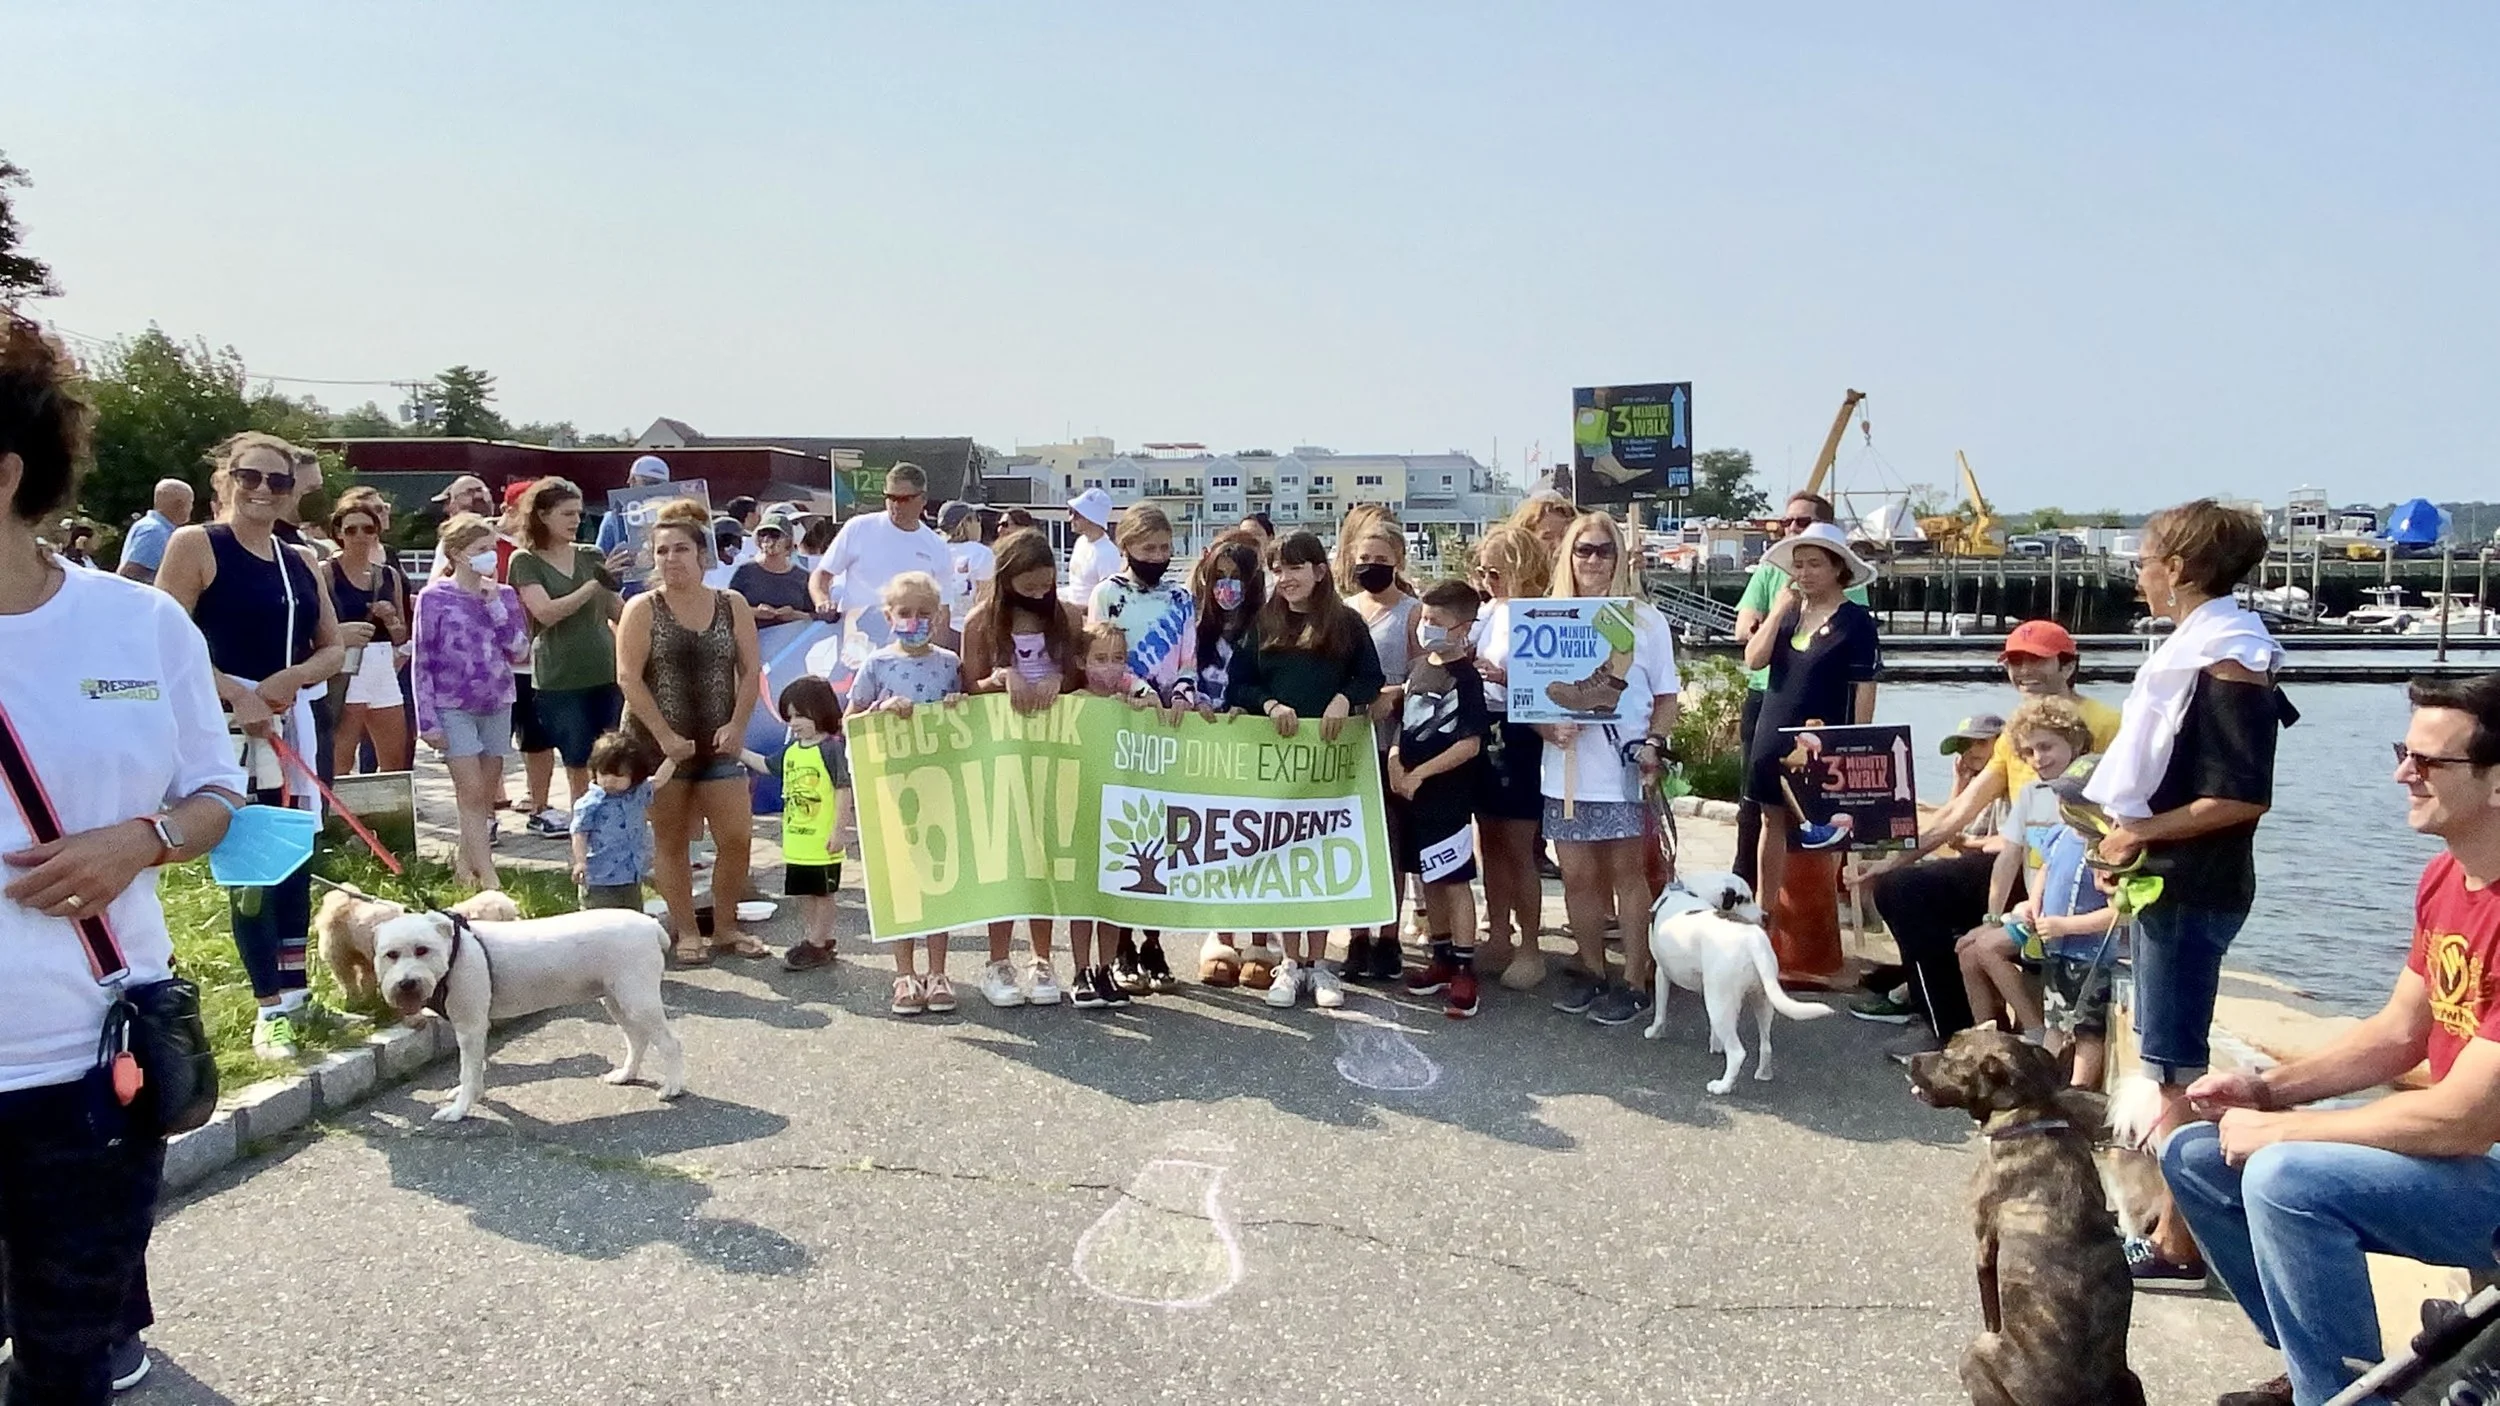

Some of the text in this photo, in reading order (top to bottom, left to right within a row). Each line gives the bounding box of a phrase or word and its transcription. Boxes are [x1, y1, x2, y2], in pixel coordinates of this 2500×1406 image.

[1611, 405, 1631, 437] 3
[851, 470, 873, 491] 12
[1513, 624, 1558, 658] 20
[1114, 728, 1357, 783] SHOP DINE EXPLORE
[1821, 755, 1846, 791] 3
[1166, 805, 1352, 870] RESIDENTS
[1169, 837, 1363, 899] FORWARD
